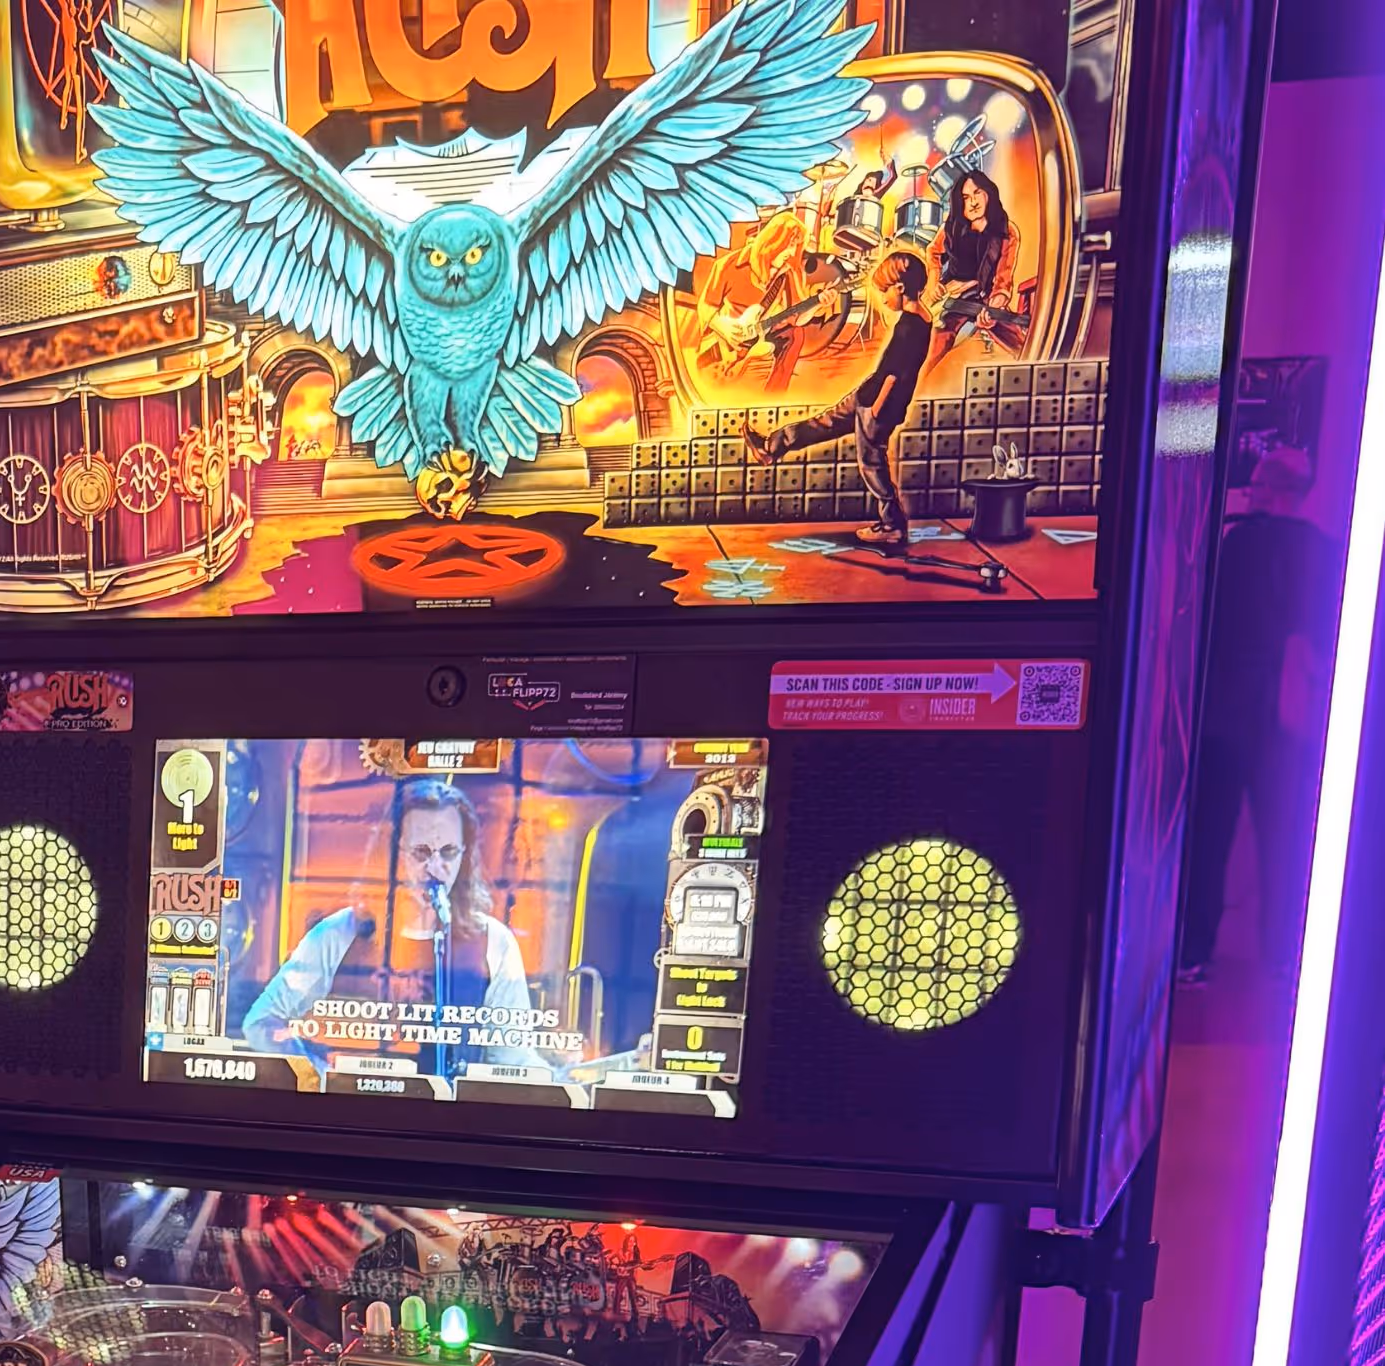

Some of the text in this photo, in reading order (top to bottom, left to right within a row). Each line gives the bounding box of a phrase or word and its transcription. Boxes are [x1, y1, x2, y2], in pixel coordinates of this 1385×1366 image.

[46, 673, 109, 712] RUSH
[513, 688, 556, 697] FLIPP72
[786, 678, 819, 691] SCAN
[822, 678, 849, 691] THIS
[852, 677, 885, 691] CODE
[893, 677, 922, 690] SIGN
[925, 677, 943, 690] UP
[945, 677, 979, 690] NOW!
[929, 698, 975, 715] INSIDER
[51, 719, 108, 729] PRO EDITION
[179, 789, 194, 824] 1
[150, 873, 224, 916] RUSH
[158, 921, 212, 938] 1 2 3
[314, 1000, 560, 1028] SHOOT LIT RECORDS
[288, 1019, 583, 1050] TO LIGHT TIME MACHINE
[9, 1167, 46, 1179] USA
